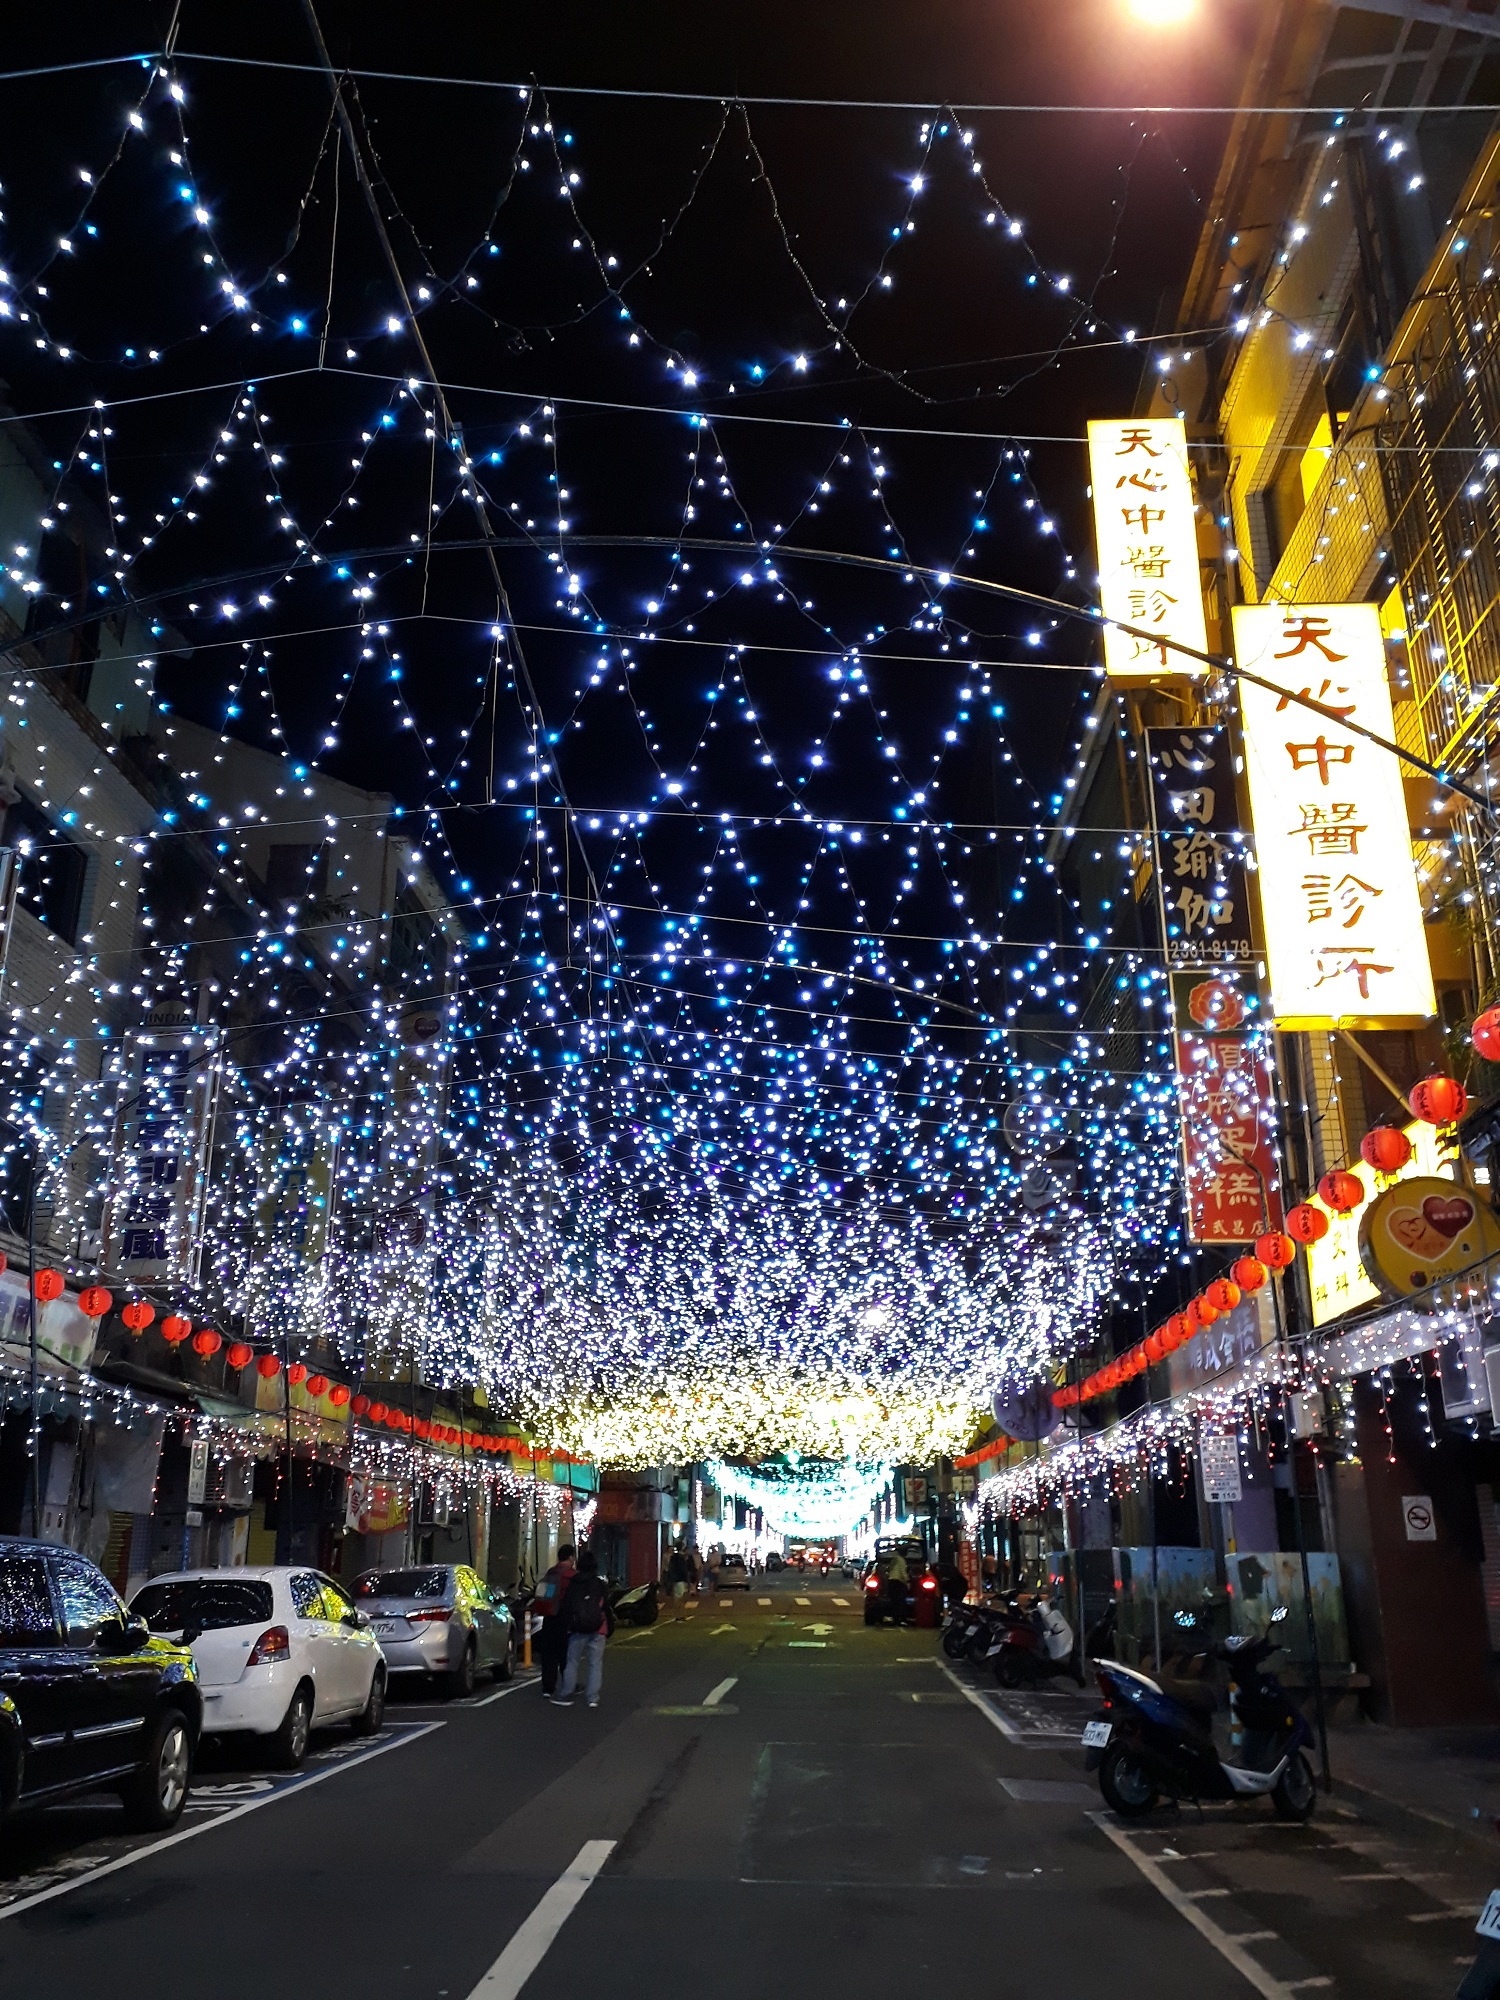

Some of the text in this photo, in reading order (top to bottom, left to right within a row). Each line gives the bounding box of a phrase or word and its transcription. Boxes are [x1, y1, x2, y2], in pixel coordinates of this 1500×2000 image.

[1115, 428, 1177, 666] 天心中醫診所
[1161, 734, 1234, 935] 心田瑜伽
[1275, 618, 1395, 999] 天心中醫診所
[1211, 1219, 1268, 1236] 武昌店
